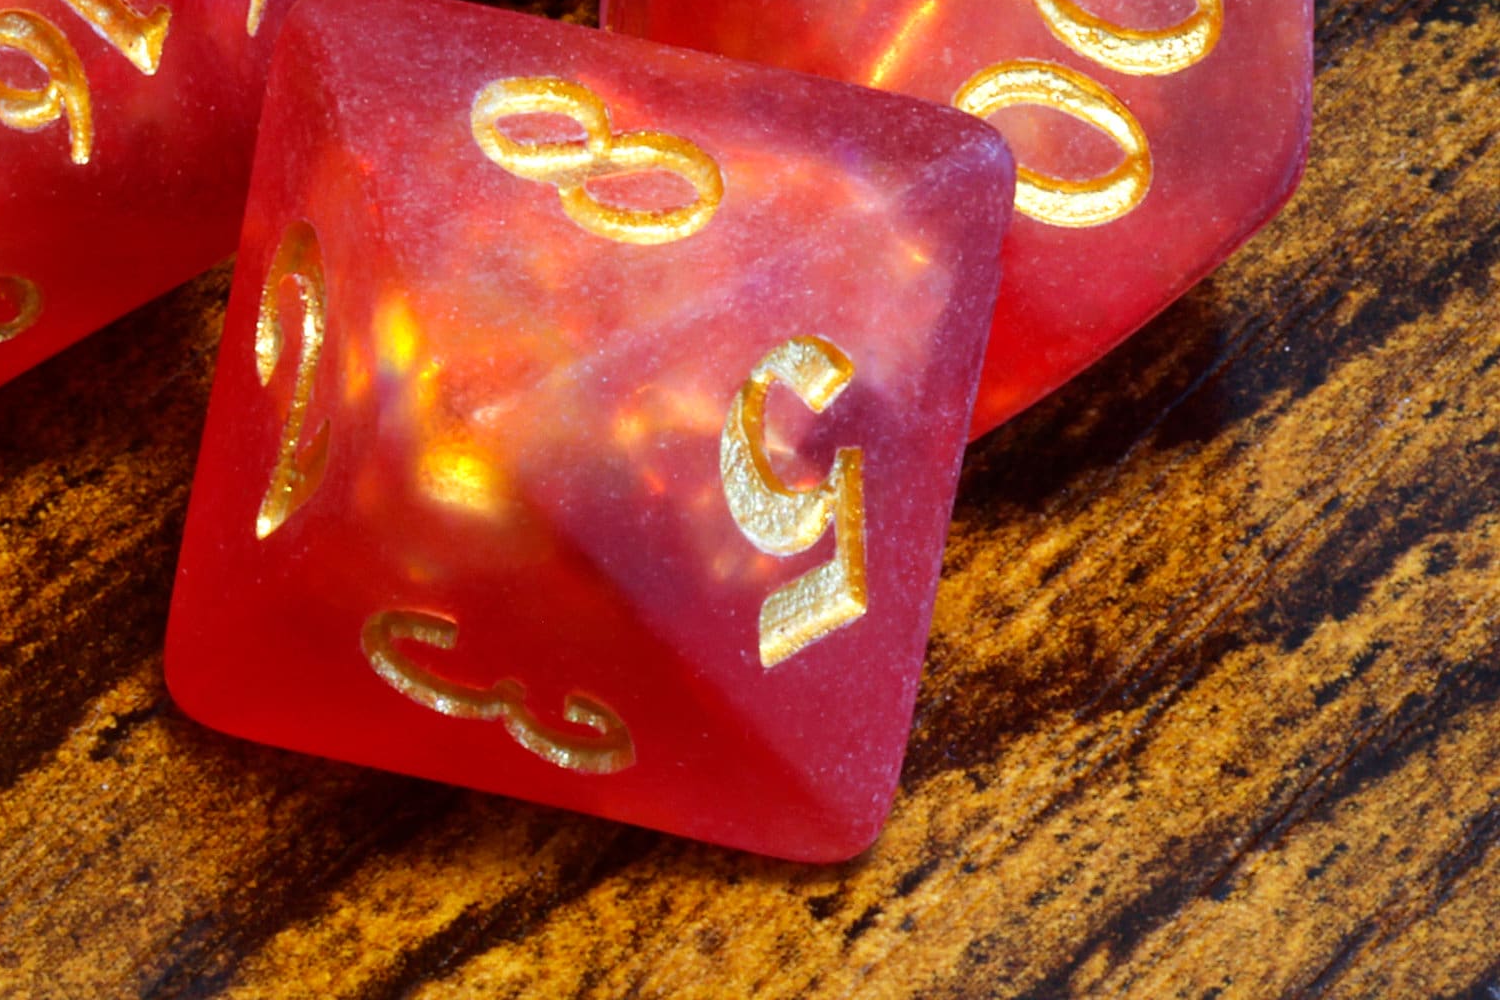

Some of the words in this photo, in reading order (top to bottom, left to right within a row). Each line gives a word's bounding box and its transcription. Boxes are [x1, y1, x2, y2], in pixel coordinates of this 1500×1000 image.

[469, 76, 725, 246] 8
[719, 334, 867, 669] 5
[360, 609, 637, 774] 3
